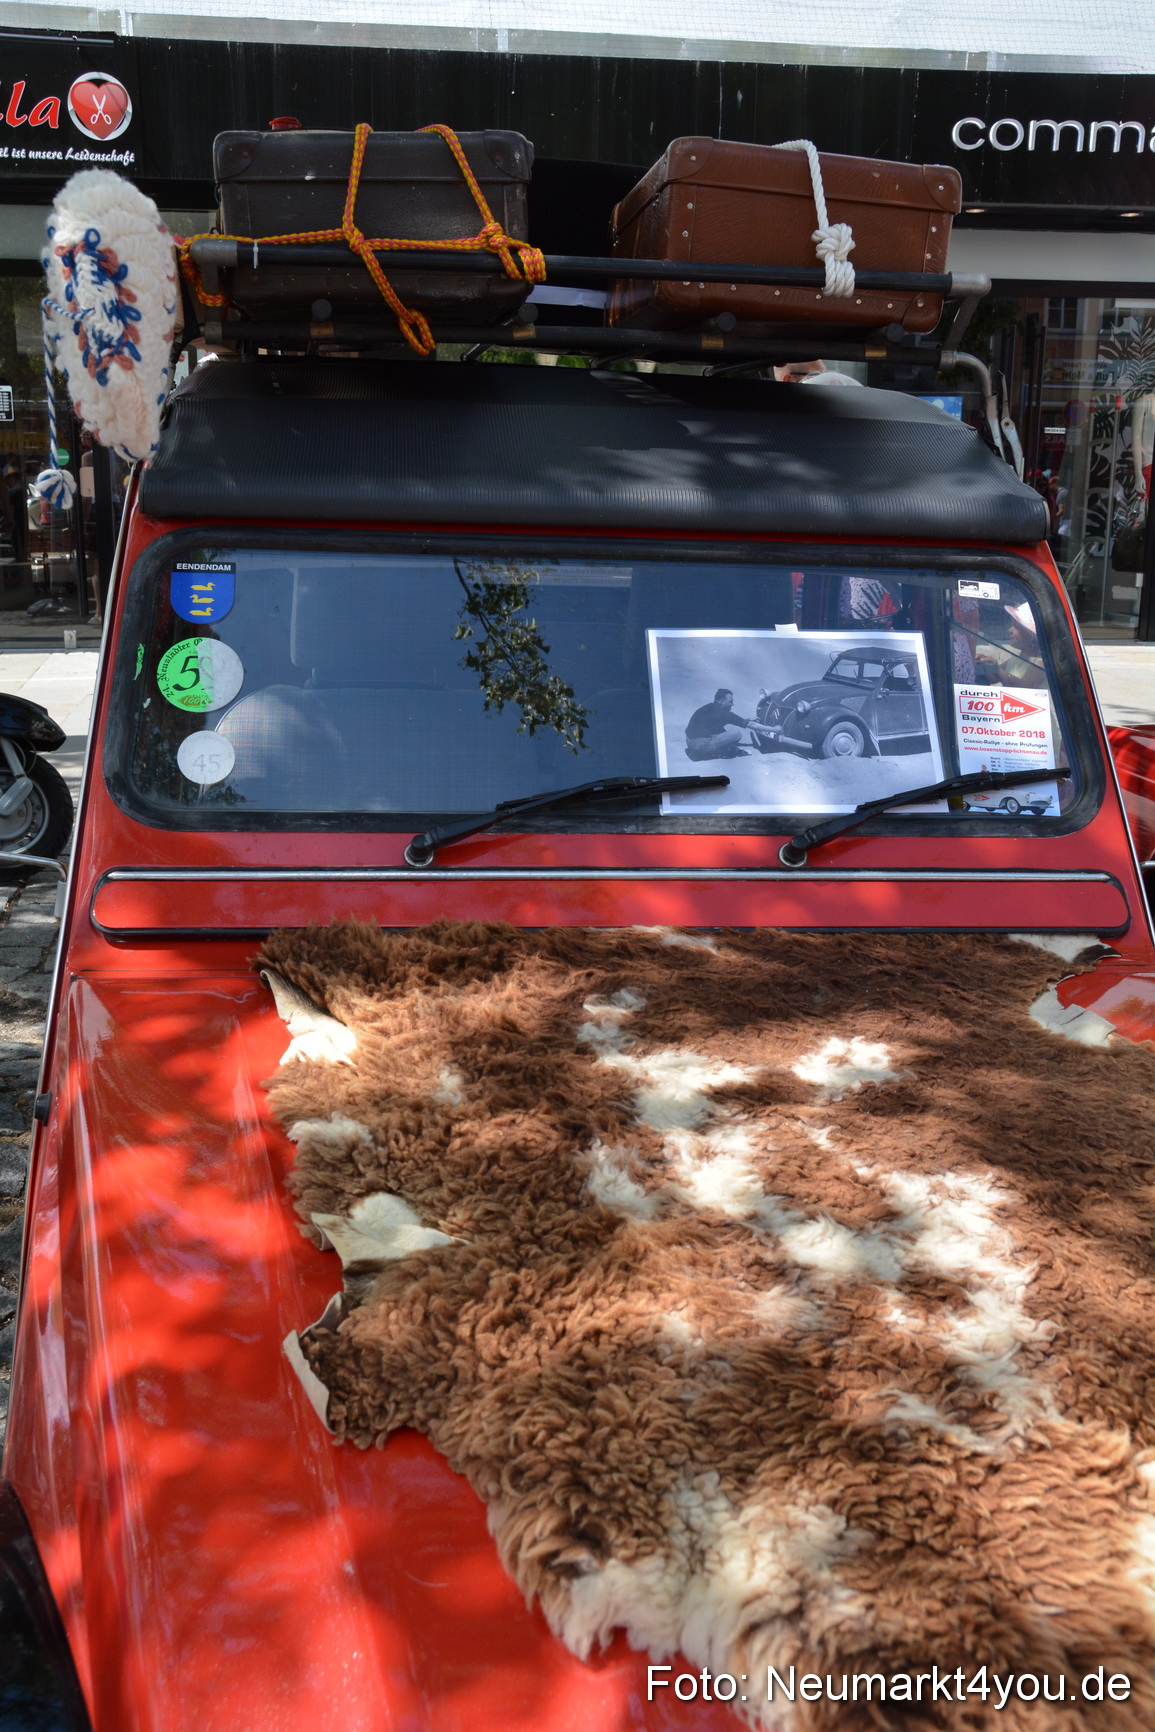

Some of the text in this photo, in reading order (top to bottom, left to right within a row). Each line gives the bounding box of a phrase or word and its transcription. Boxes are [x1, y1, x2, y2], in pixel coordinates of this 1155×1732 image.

[0, 80, 61, 129] la
[952, 116, 1155, 153] comm
[11, 148, 27, 159] ist
[28, 149, 63, 160] unsere
[65, 147, 135, 166] Leidenschaft
[176, 562, 232, 571] EENDENDAM
[960, 689, 999, 698] durch
[967, 700, 1025, 713] 100 km
[962, 714, 1001, 723] Bayern
[961, 725, 1046, 739] 07.Oktober 2018
[192, 753, 221, 772] 45
